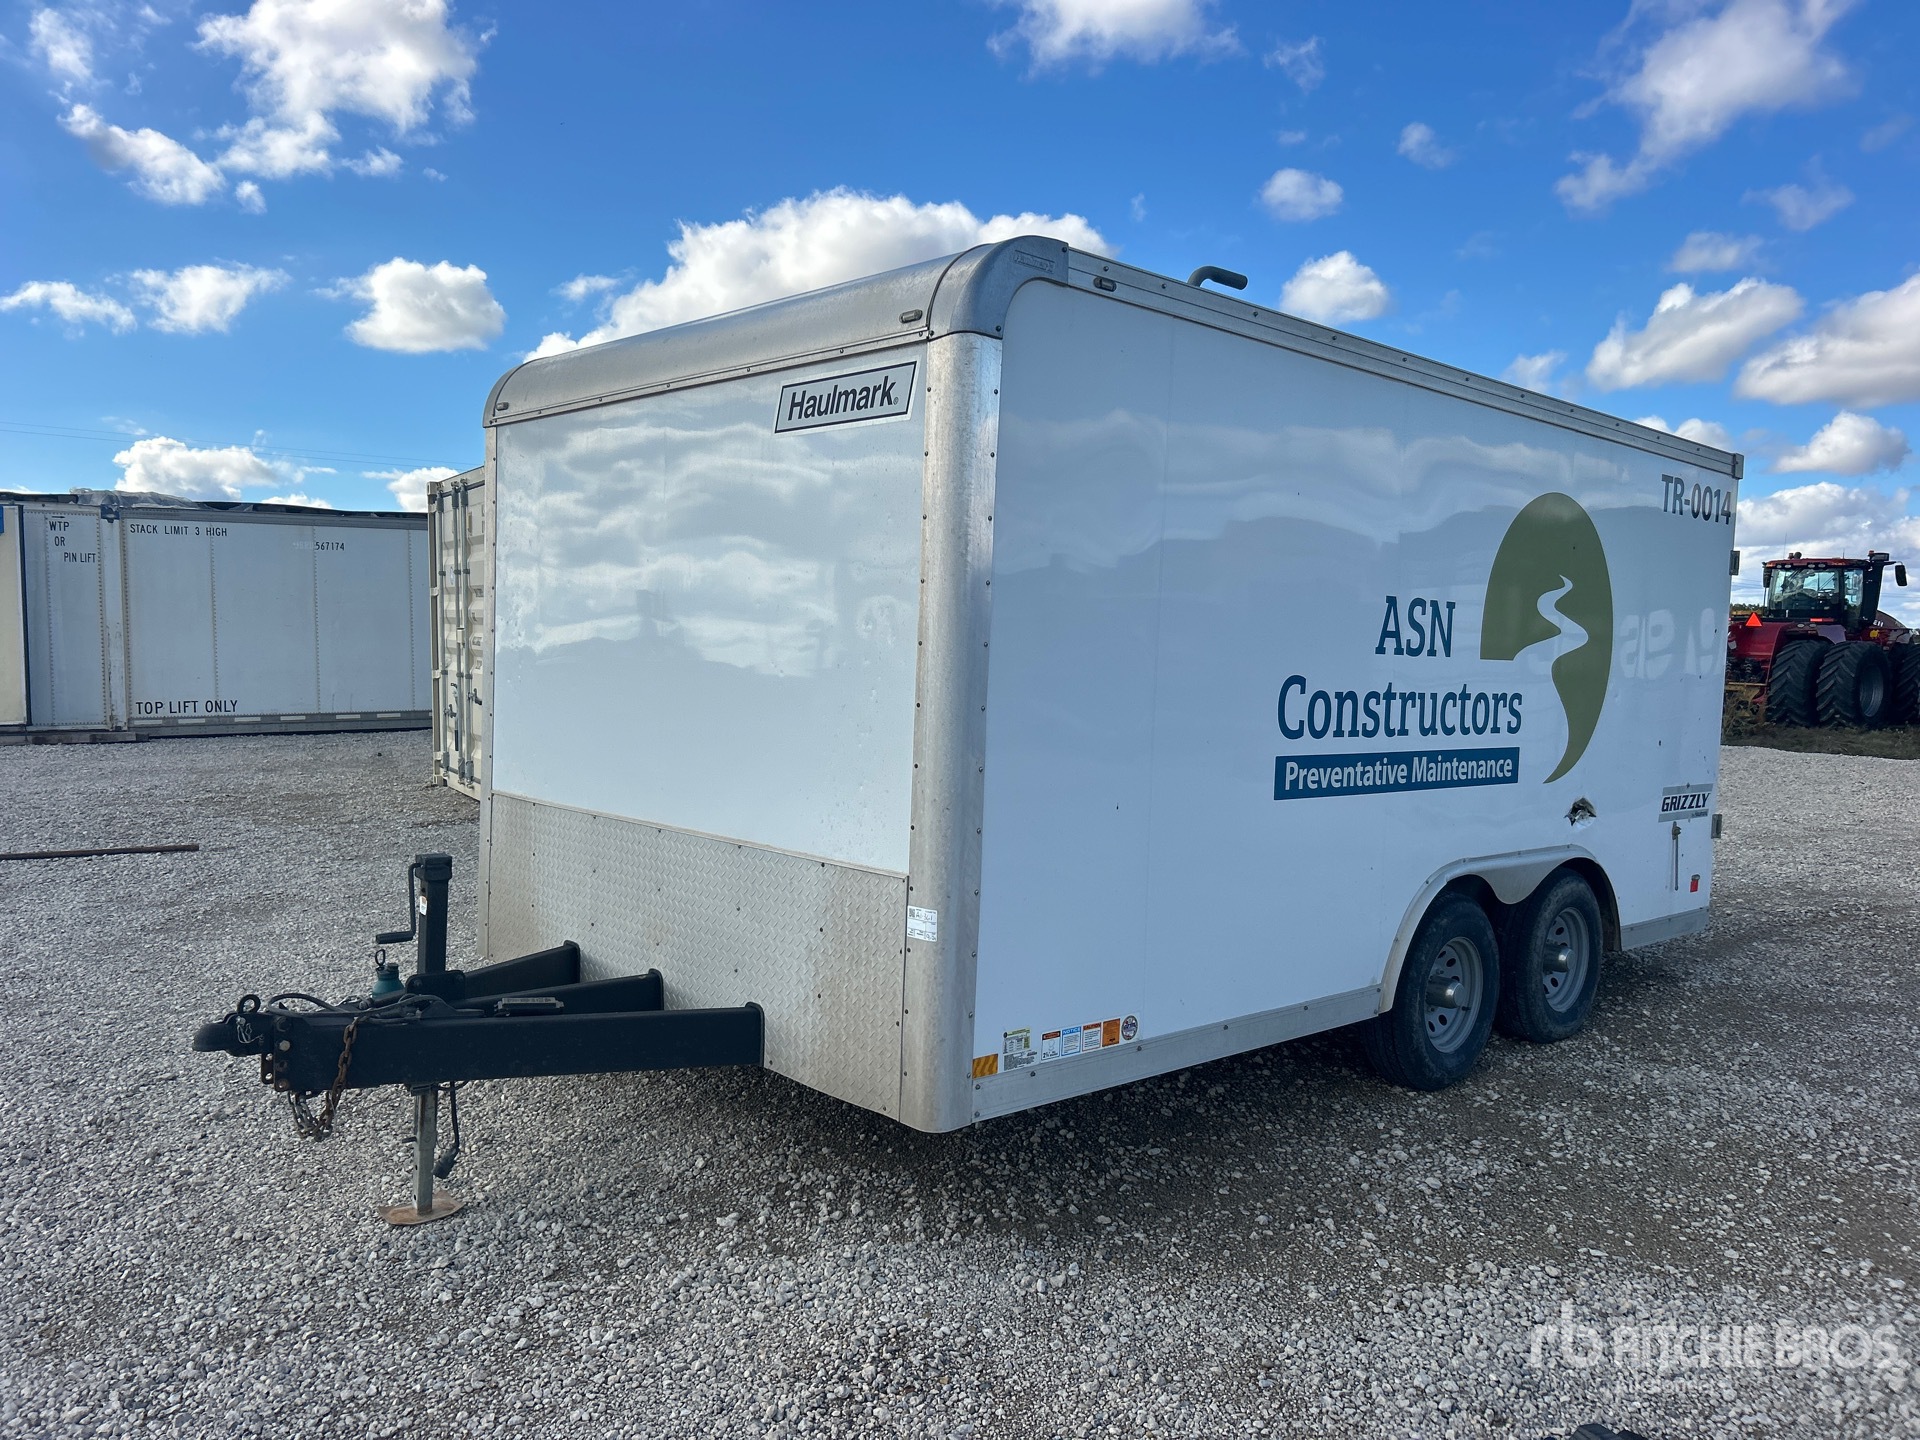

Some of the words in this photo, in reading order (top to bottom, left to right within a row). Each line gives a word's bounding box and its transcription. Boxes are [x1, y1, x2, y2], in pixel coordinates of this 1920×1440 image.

[787, 375, 897, 421] Haulmark
[1661, 473, 1732, 525] TR-0014
[49, 520, 70, 532] WTP
[129, 523, 159, 535] STACK
[164, 525, 189, 536] LIMIT
[194, 527, 201, 536] 3
[205, 527, 228, 537] HIGH
[54, 536, 66, 547] OR
[315, 541, 345, 551] 567174
[63, 551, 77, 563] PIN
[80, 553, 97, 564] LIFT
[1374, 595, 1456, 658] ASN
[135, 701, 164, 715] TOP
[169, 700, 199, 714] LIFT
[205, 699, 238, 713] ONLY
[1277, 674, 1523, 740] Constructors
[1285, 757, 1408, 791] Preventative
[1411, 755, 1513, 783] Maintenance
[1661, 792, 1712, 812] GRIZZLY
